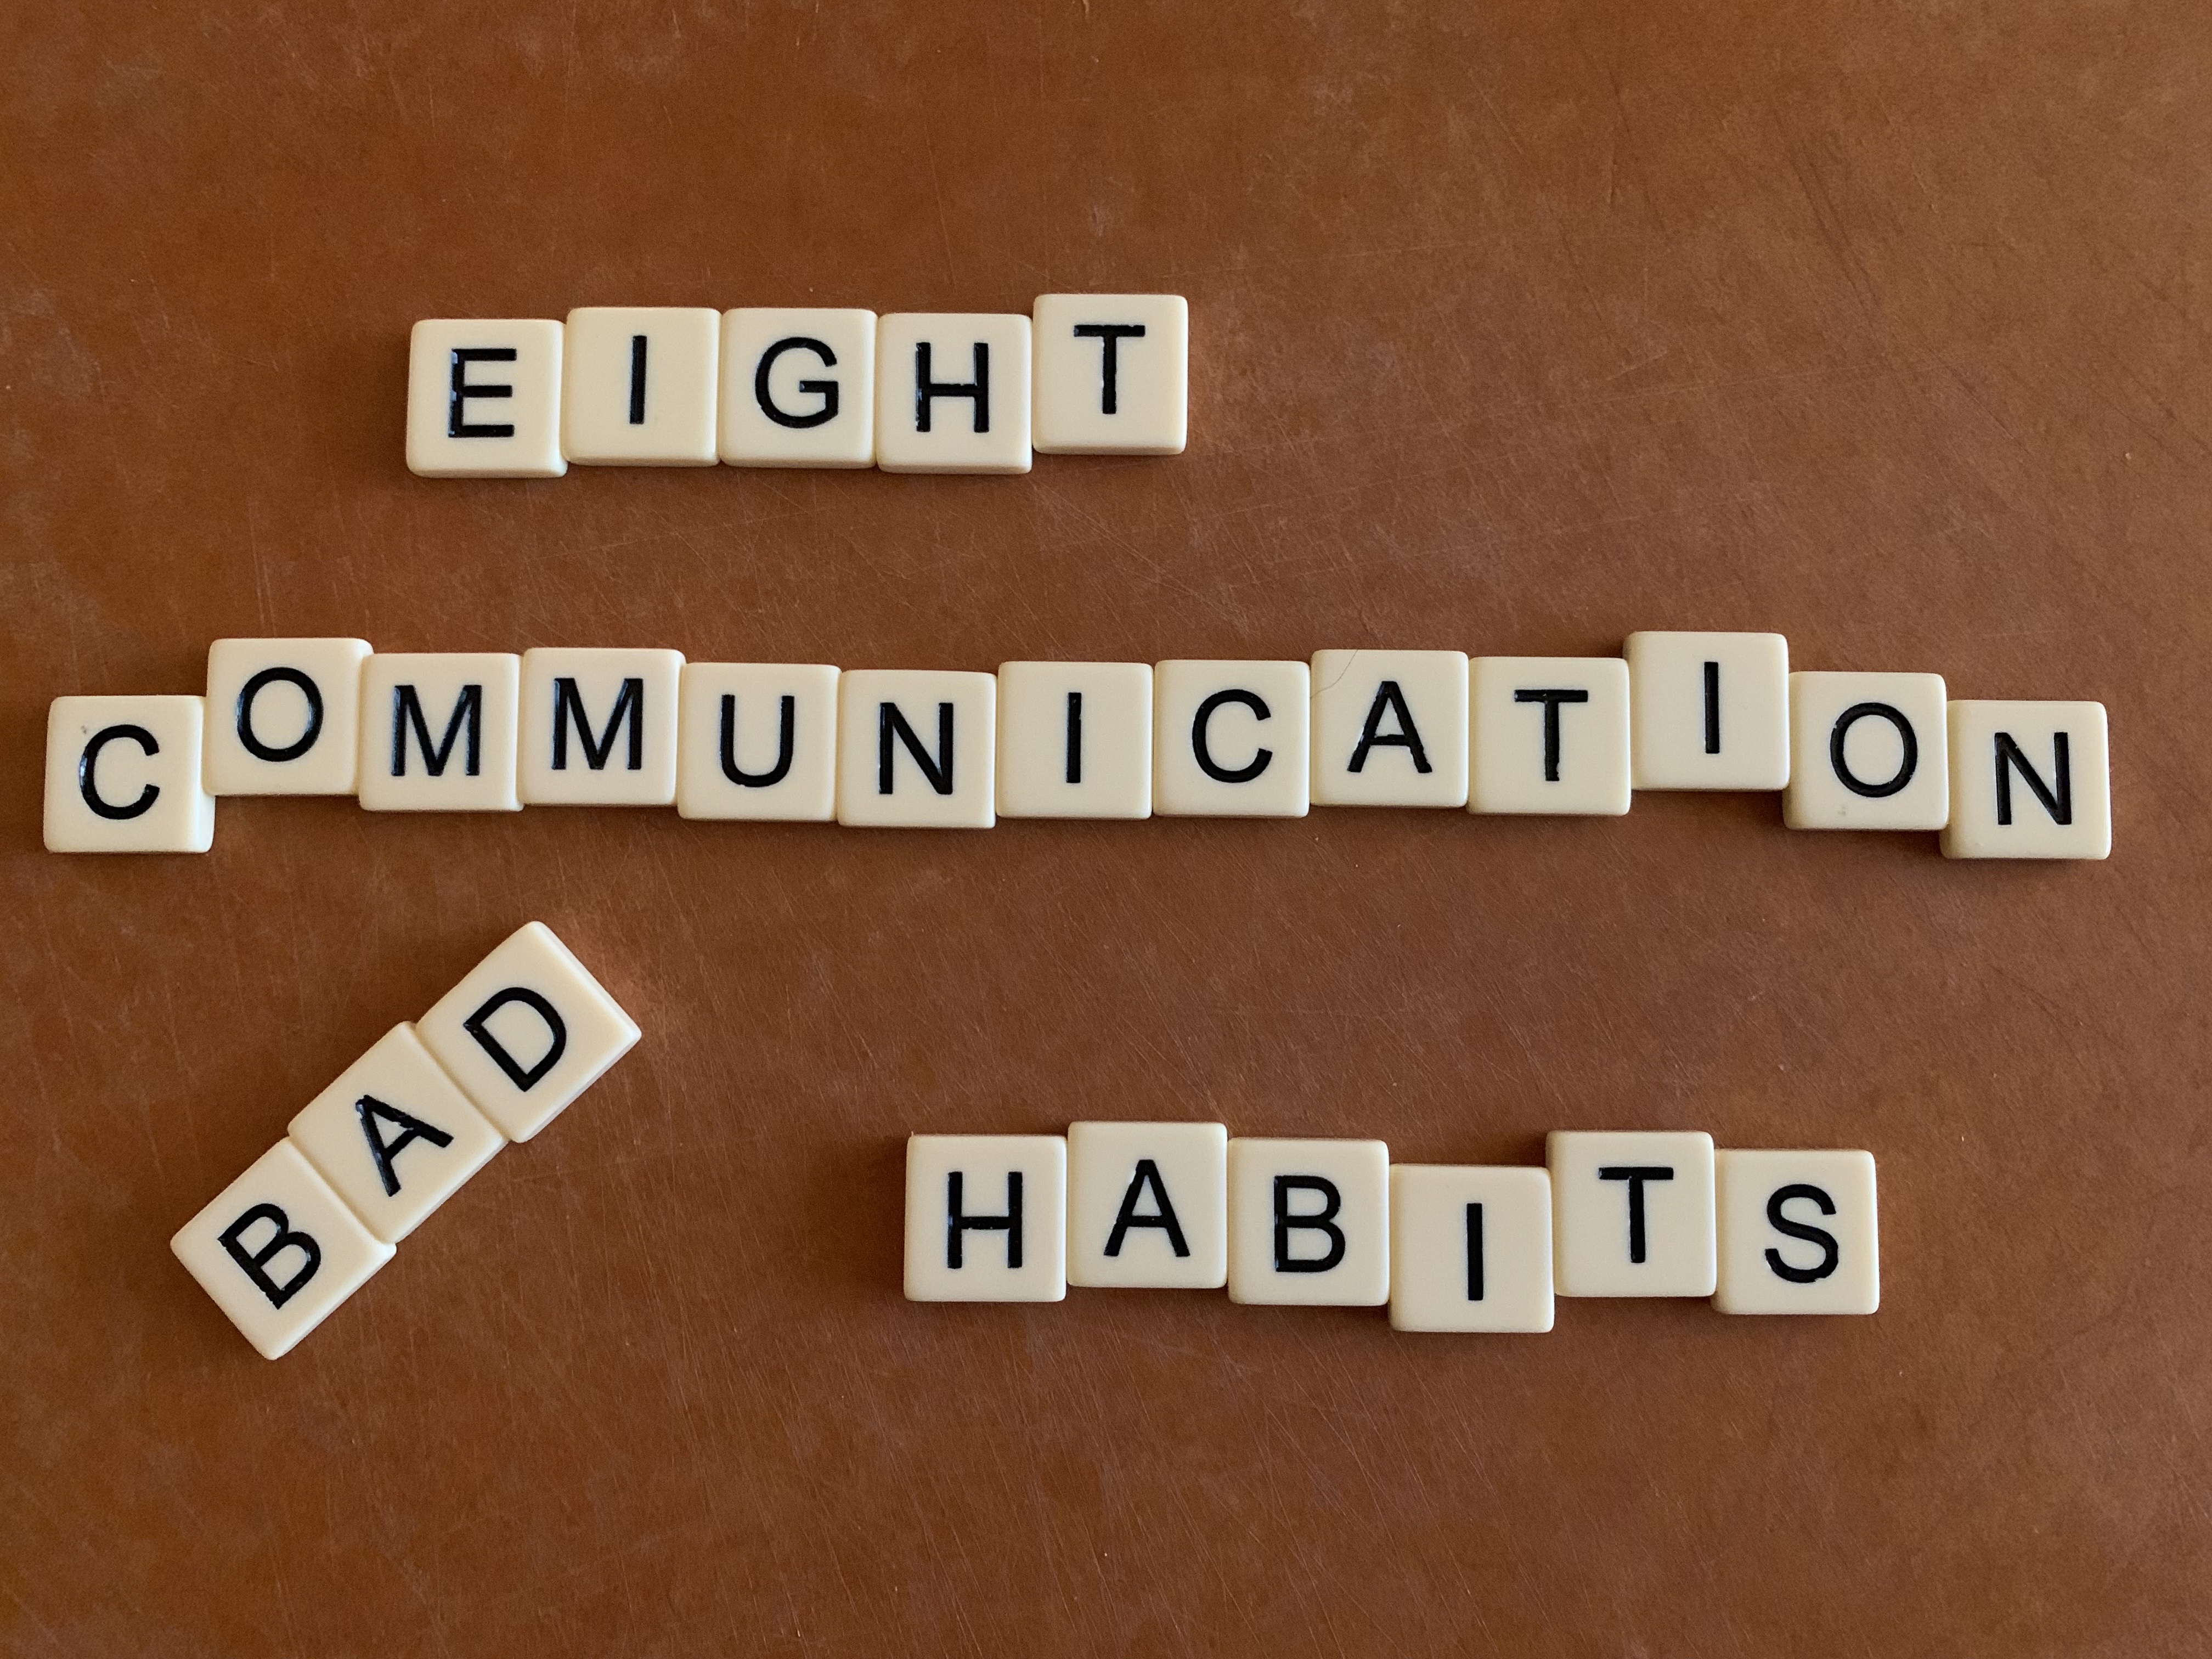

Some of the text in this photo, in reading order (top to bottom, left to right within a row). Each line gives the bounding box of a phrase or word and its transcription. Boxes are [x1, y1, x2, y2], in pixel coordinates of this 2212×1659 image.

[447, 323, 1147, 439] EIGHT
[78, 661, 2073, 826] COMMUNICATION
[216, 986, 568, 1311] BAD
[946, 1158, 1839, 1302] HABITS
